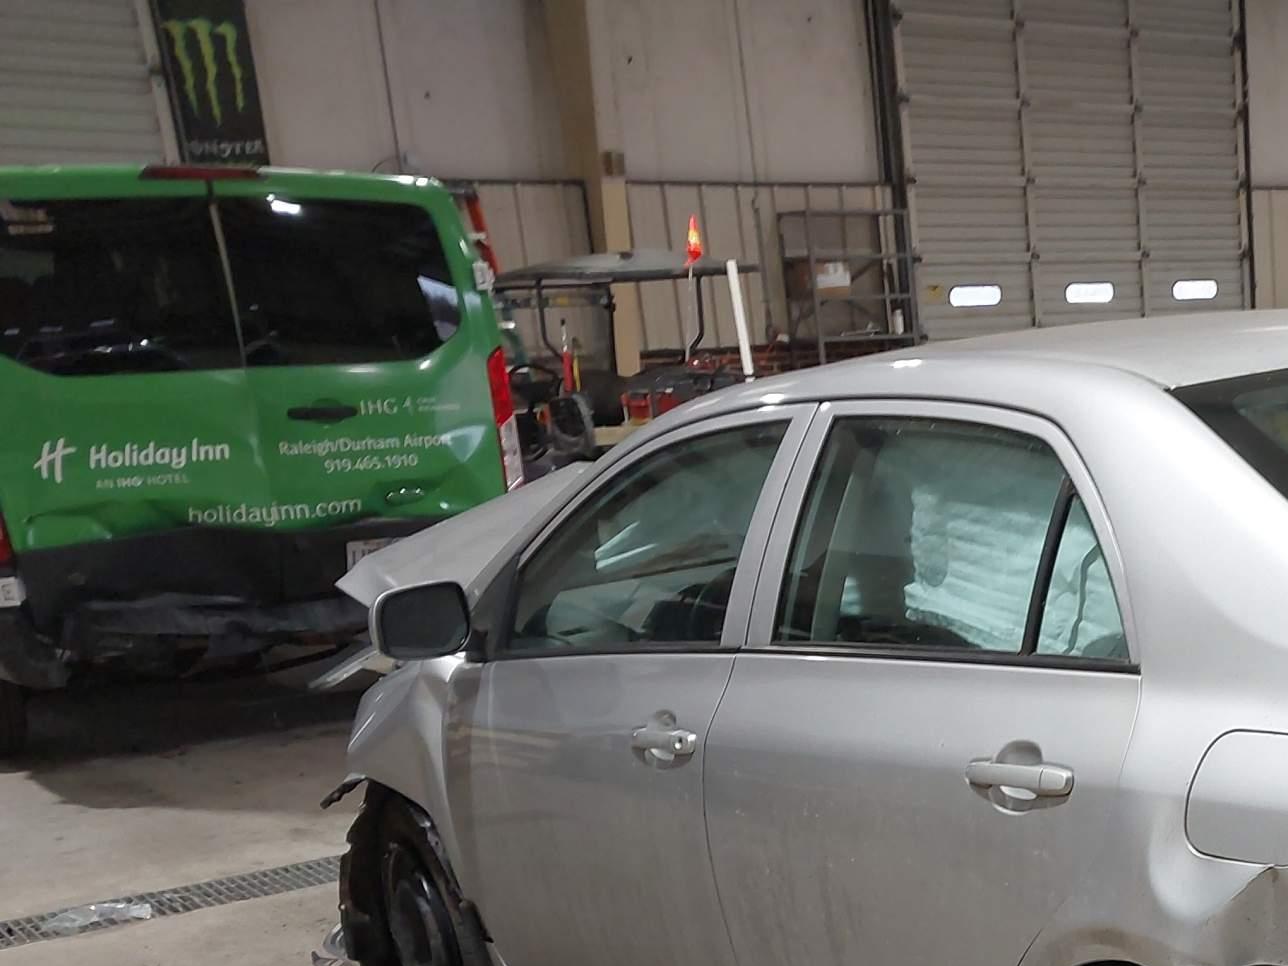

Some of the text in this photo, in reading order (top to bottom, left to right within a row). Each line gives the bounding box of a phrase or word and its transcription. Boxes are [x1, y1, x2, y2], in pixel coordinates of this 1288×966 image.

[360, 399, 397, 416] IHG
[89, 437, 230, 470] Holiday Inn
[279, 434, 451, 457] Raleigh/Durham Airport
[324, 454, 419, 475] 919.465.1910
[147, 474, 190, 487] HOTEL
[188, 499, 362, 527] holidayinn.com
